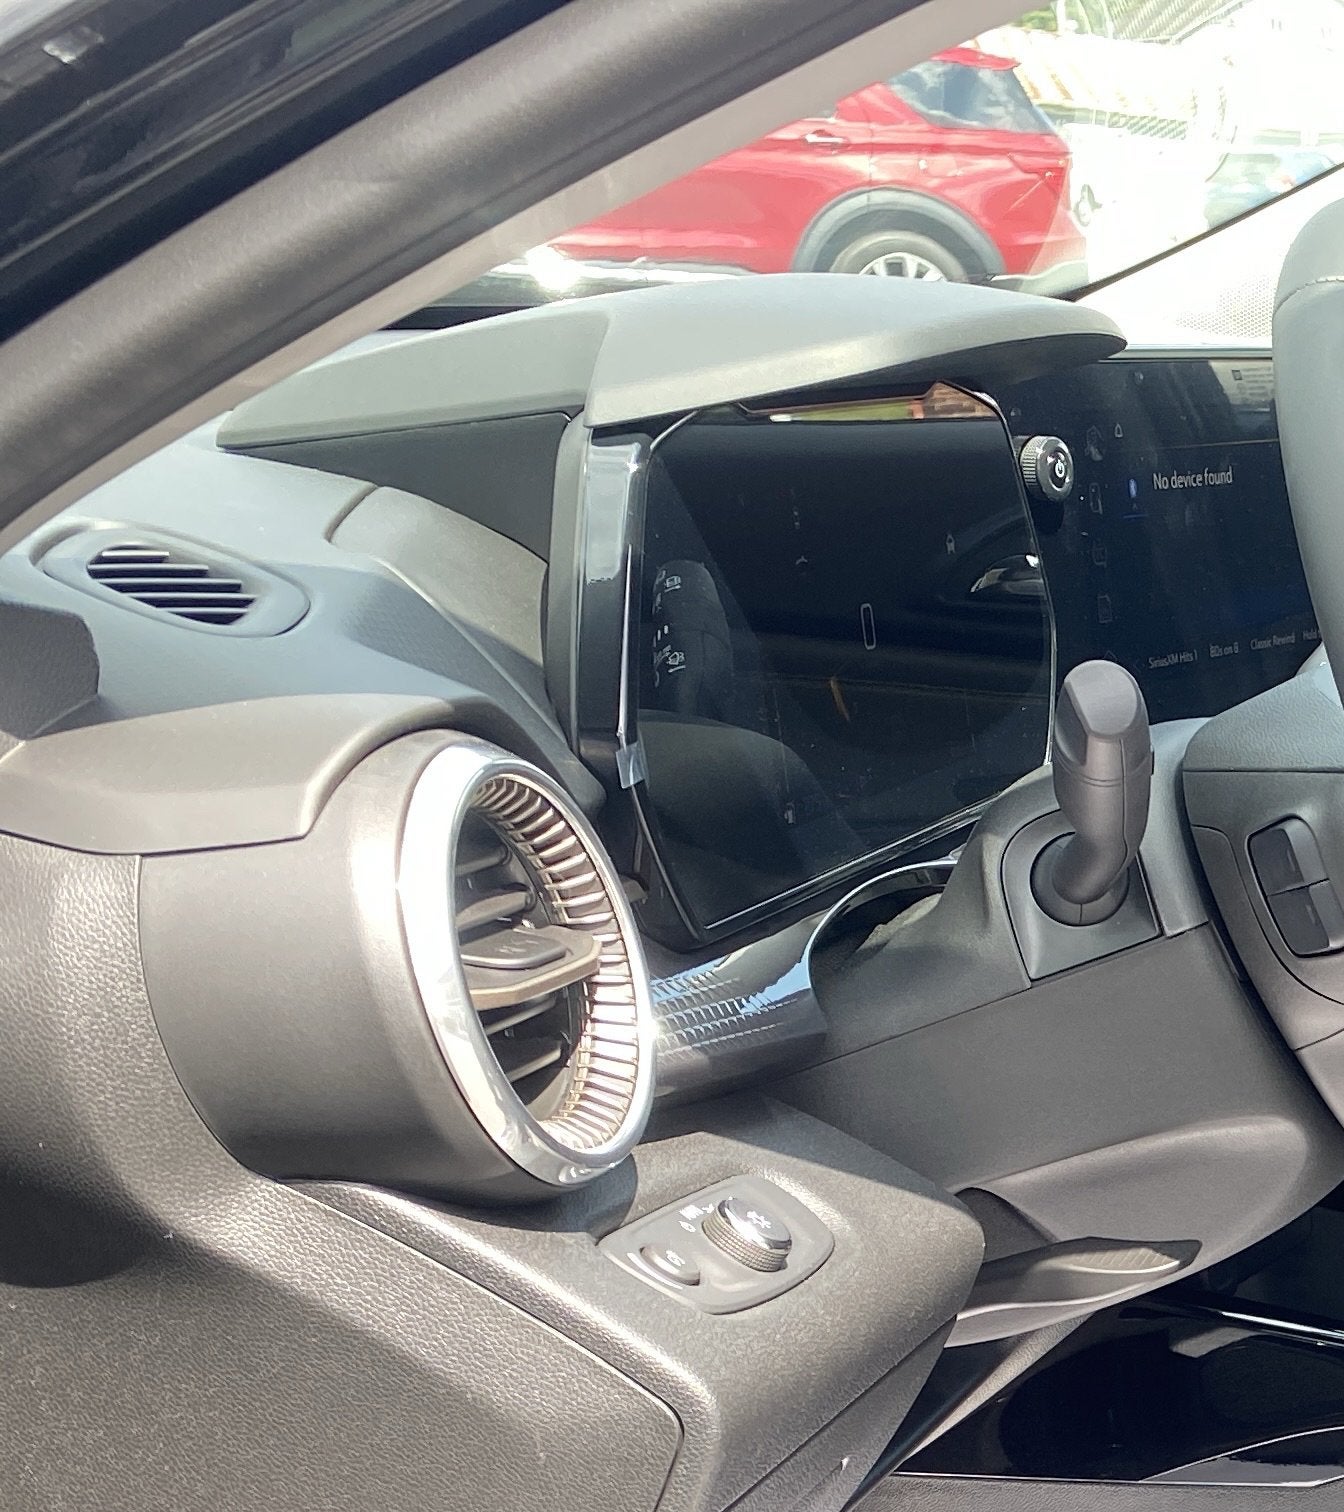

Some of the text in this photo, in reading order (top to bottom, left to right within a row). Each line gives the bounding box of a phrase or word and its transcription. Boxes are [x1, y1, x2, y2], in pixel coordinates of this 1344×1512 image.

[1153, 466, 1233, 490] No device found
